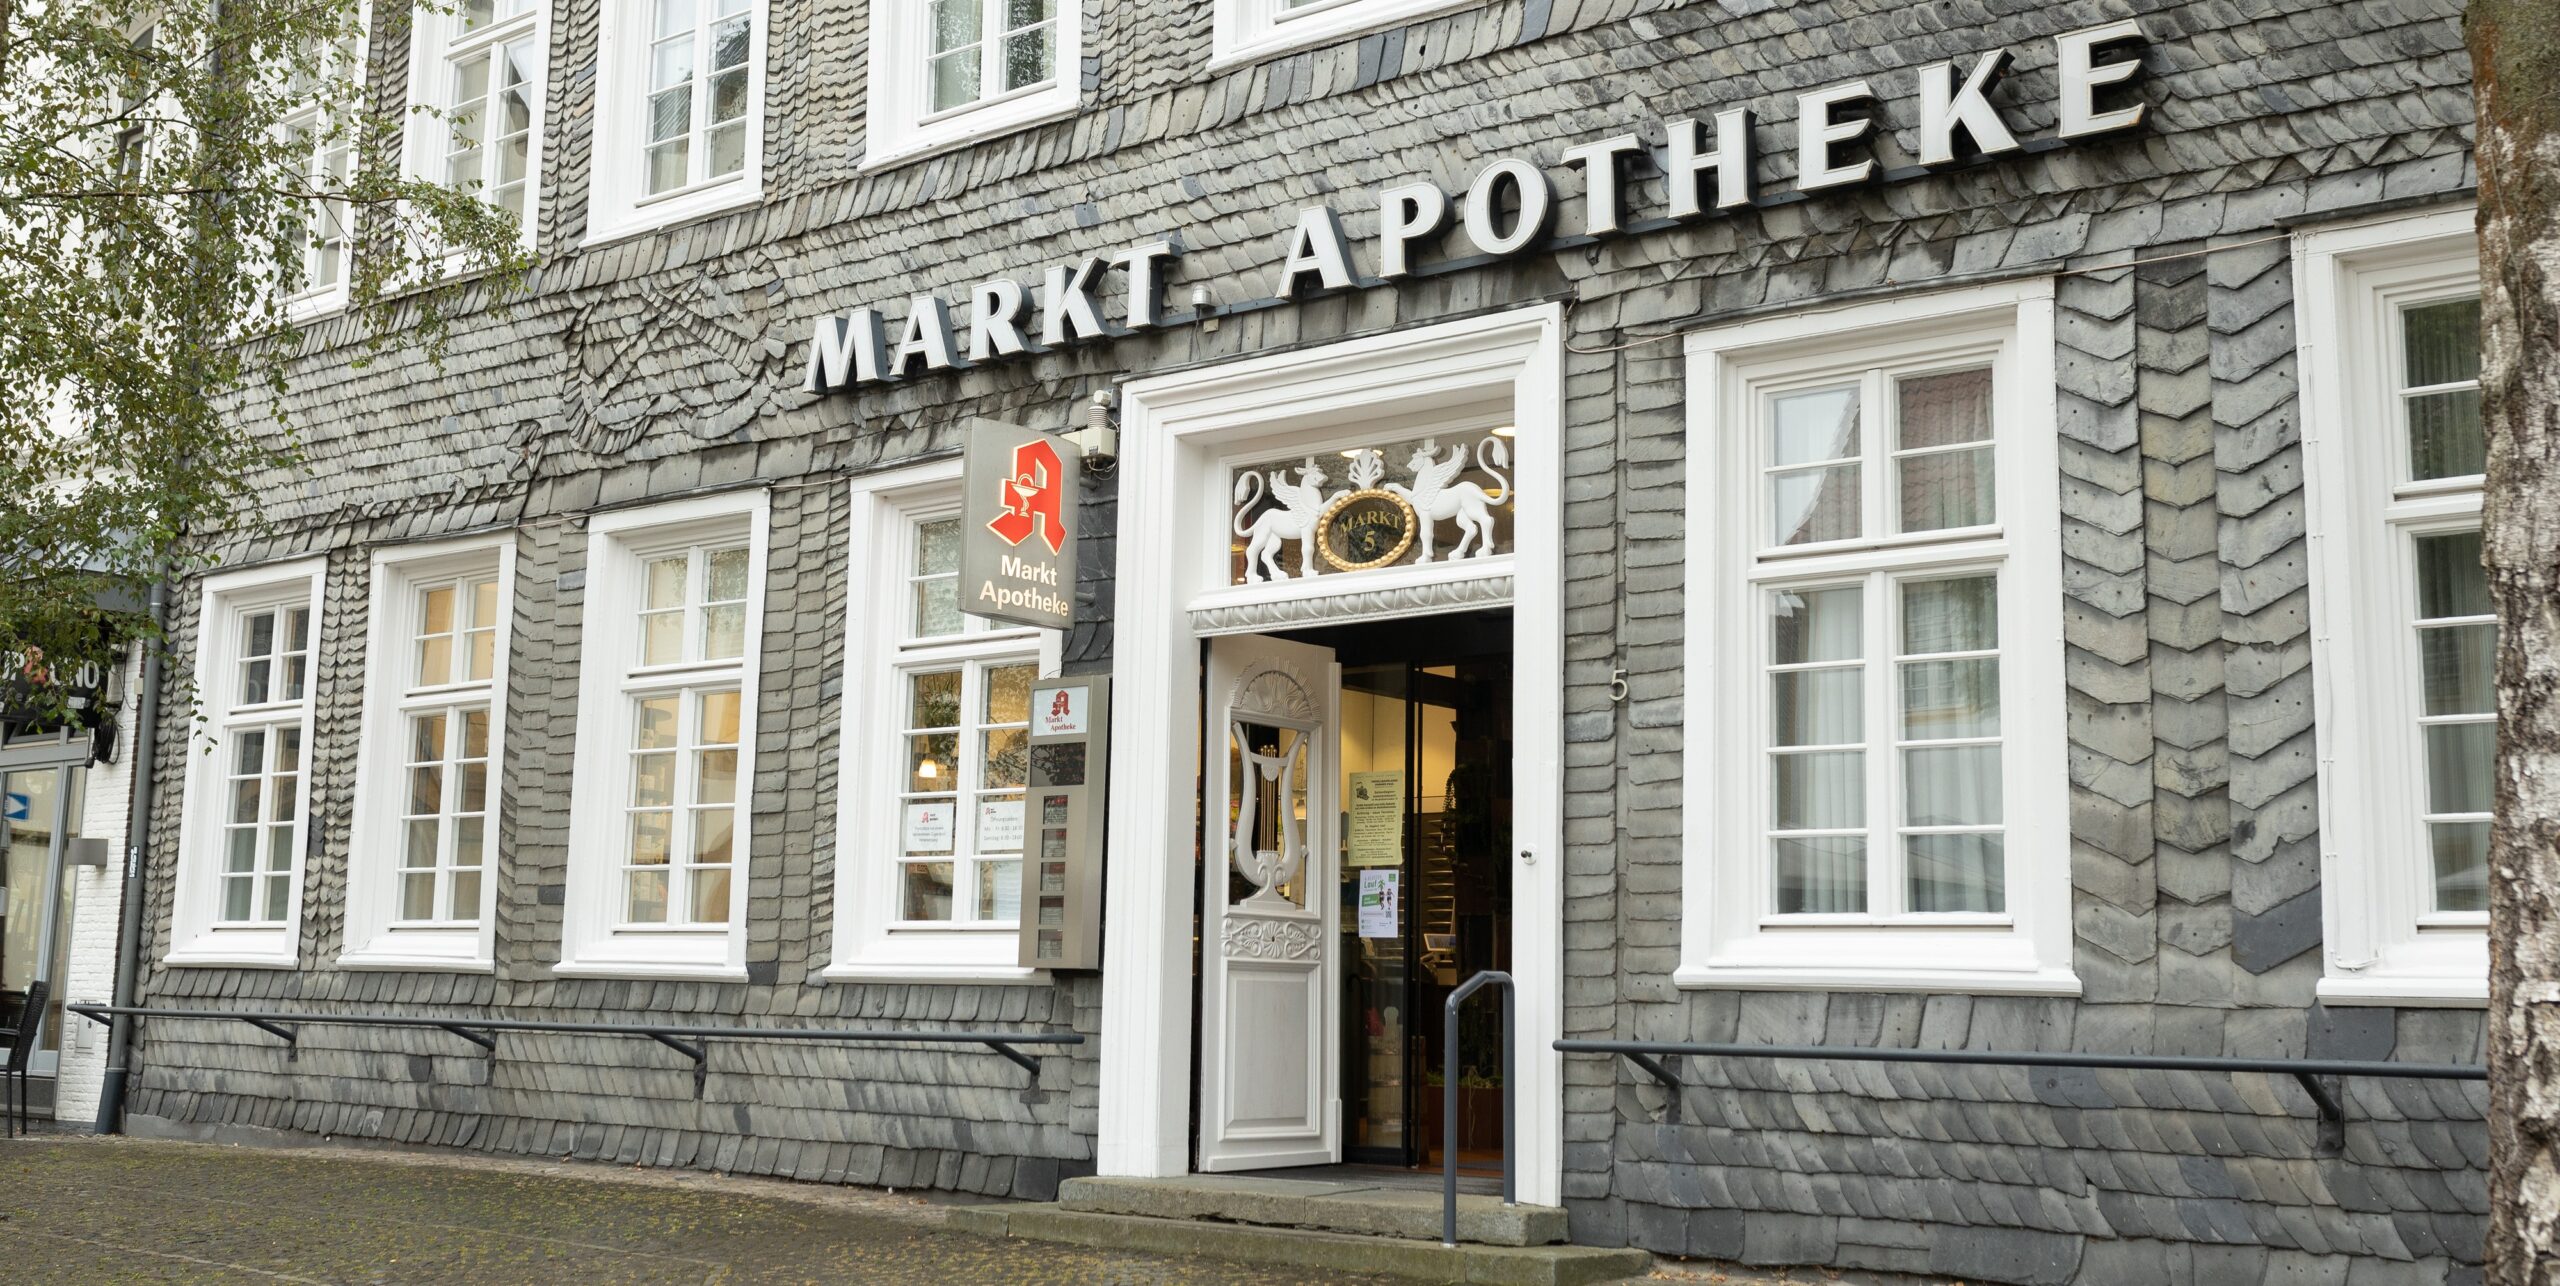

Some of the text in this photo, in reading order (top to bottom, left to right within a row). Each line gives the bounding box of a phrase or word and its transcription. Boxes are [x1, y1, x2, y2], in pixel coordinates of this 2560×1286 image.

[802, 22, 2147, 394] MARKT APOTHEKE
[1340, 510, 1401, 533] MARKT
[1364, 530, 1376, 551] 5
[1001, 555, 1057, 586] Markt
[979, 580, 1069, 616] Apotheke
[1609, 669, 1628, 700] 5
[1045, 716, 1063, 724] Markt
[1051, 723, 1076, 732] Apotheke
